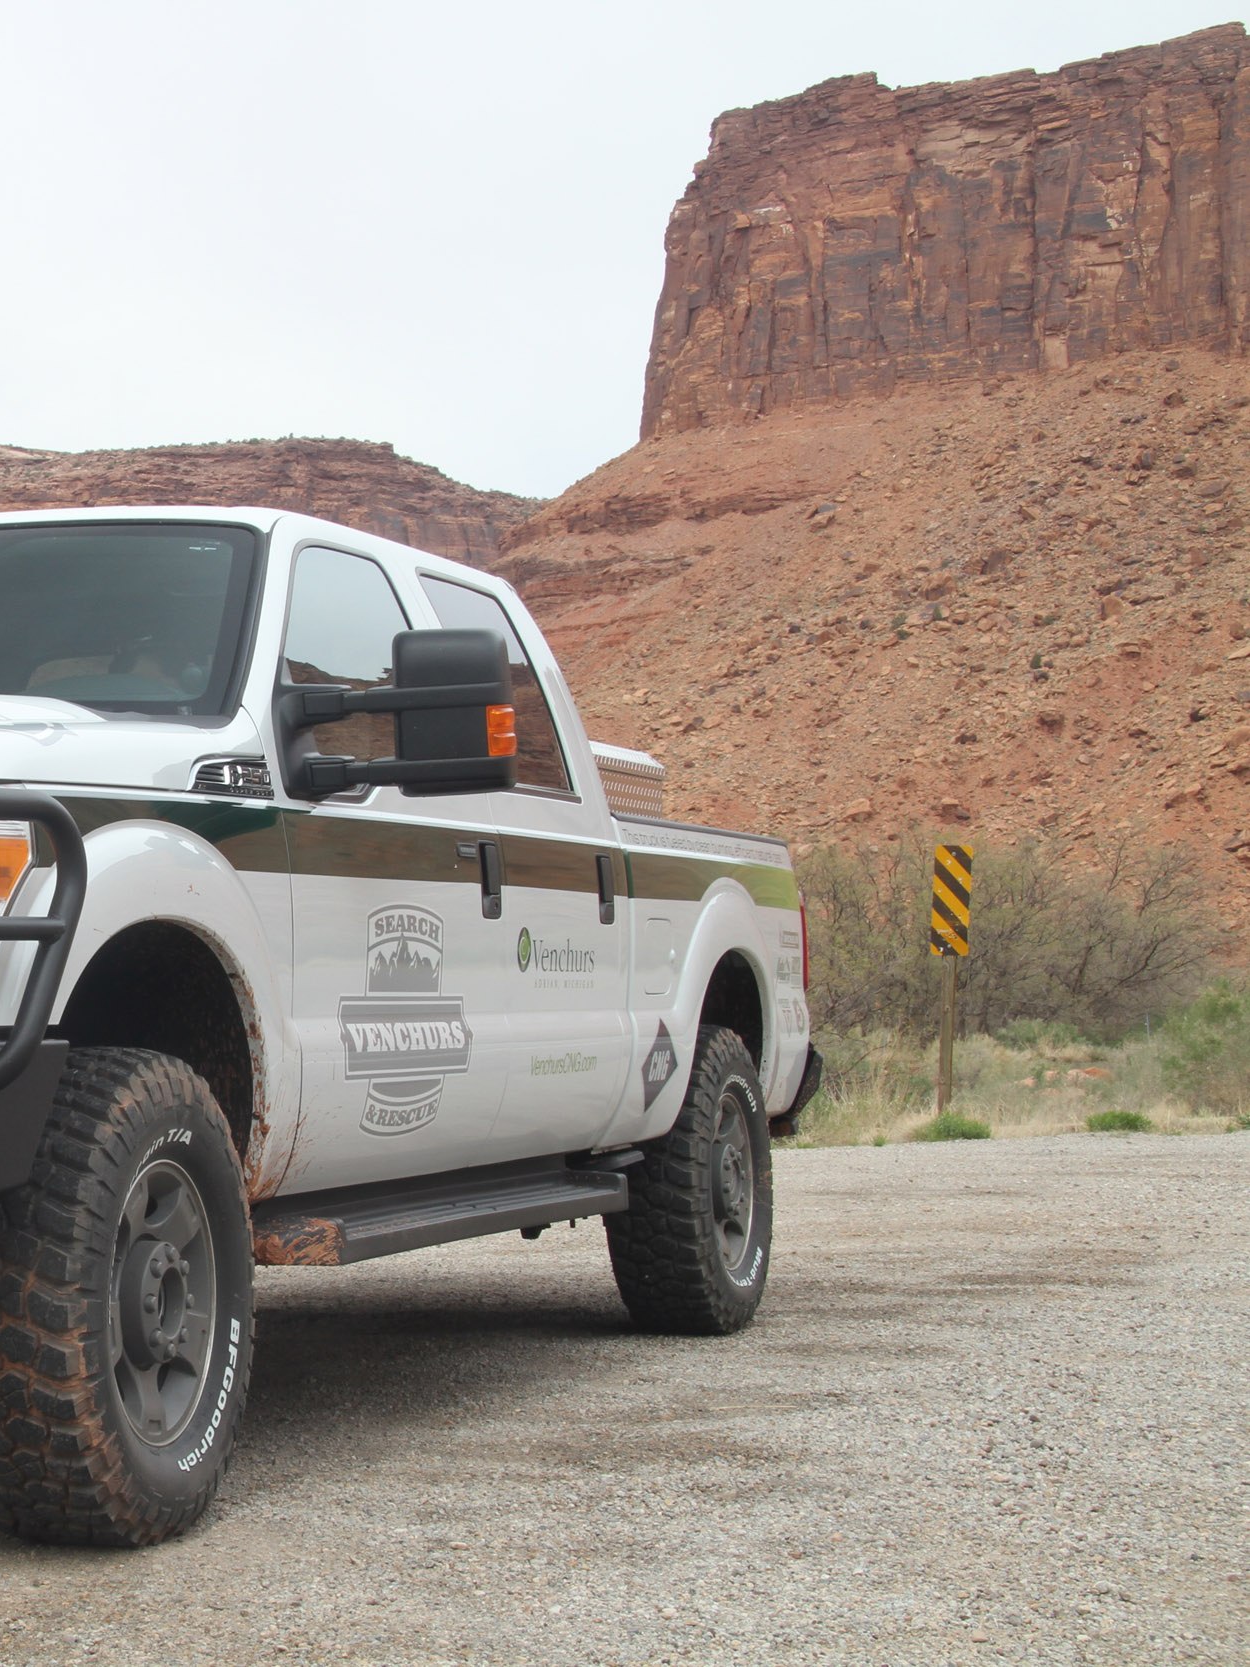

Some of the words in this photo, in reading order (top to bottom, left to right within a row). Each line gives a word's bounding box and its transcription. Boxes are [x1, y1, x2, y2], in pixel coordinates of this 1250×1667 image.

[374, 914, 440, 943] SEARCH
[533, 938, 595, 973] Venchurs
[345, 1021, 466, 1053] VENCHURS
[530, 1052, 597, 1077] VenchursCNG.com
[648, 1050, 670, 1082] CNG
[167, 1128, 192, 1145] T/A
[177, 1317, 241, 1472] BFGoodrich
